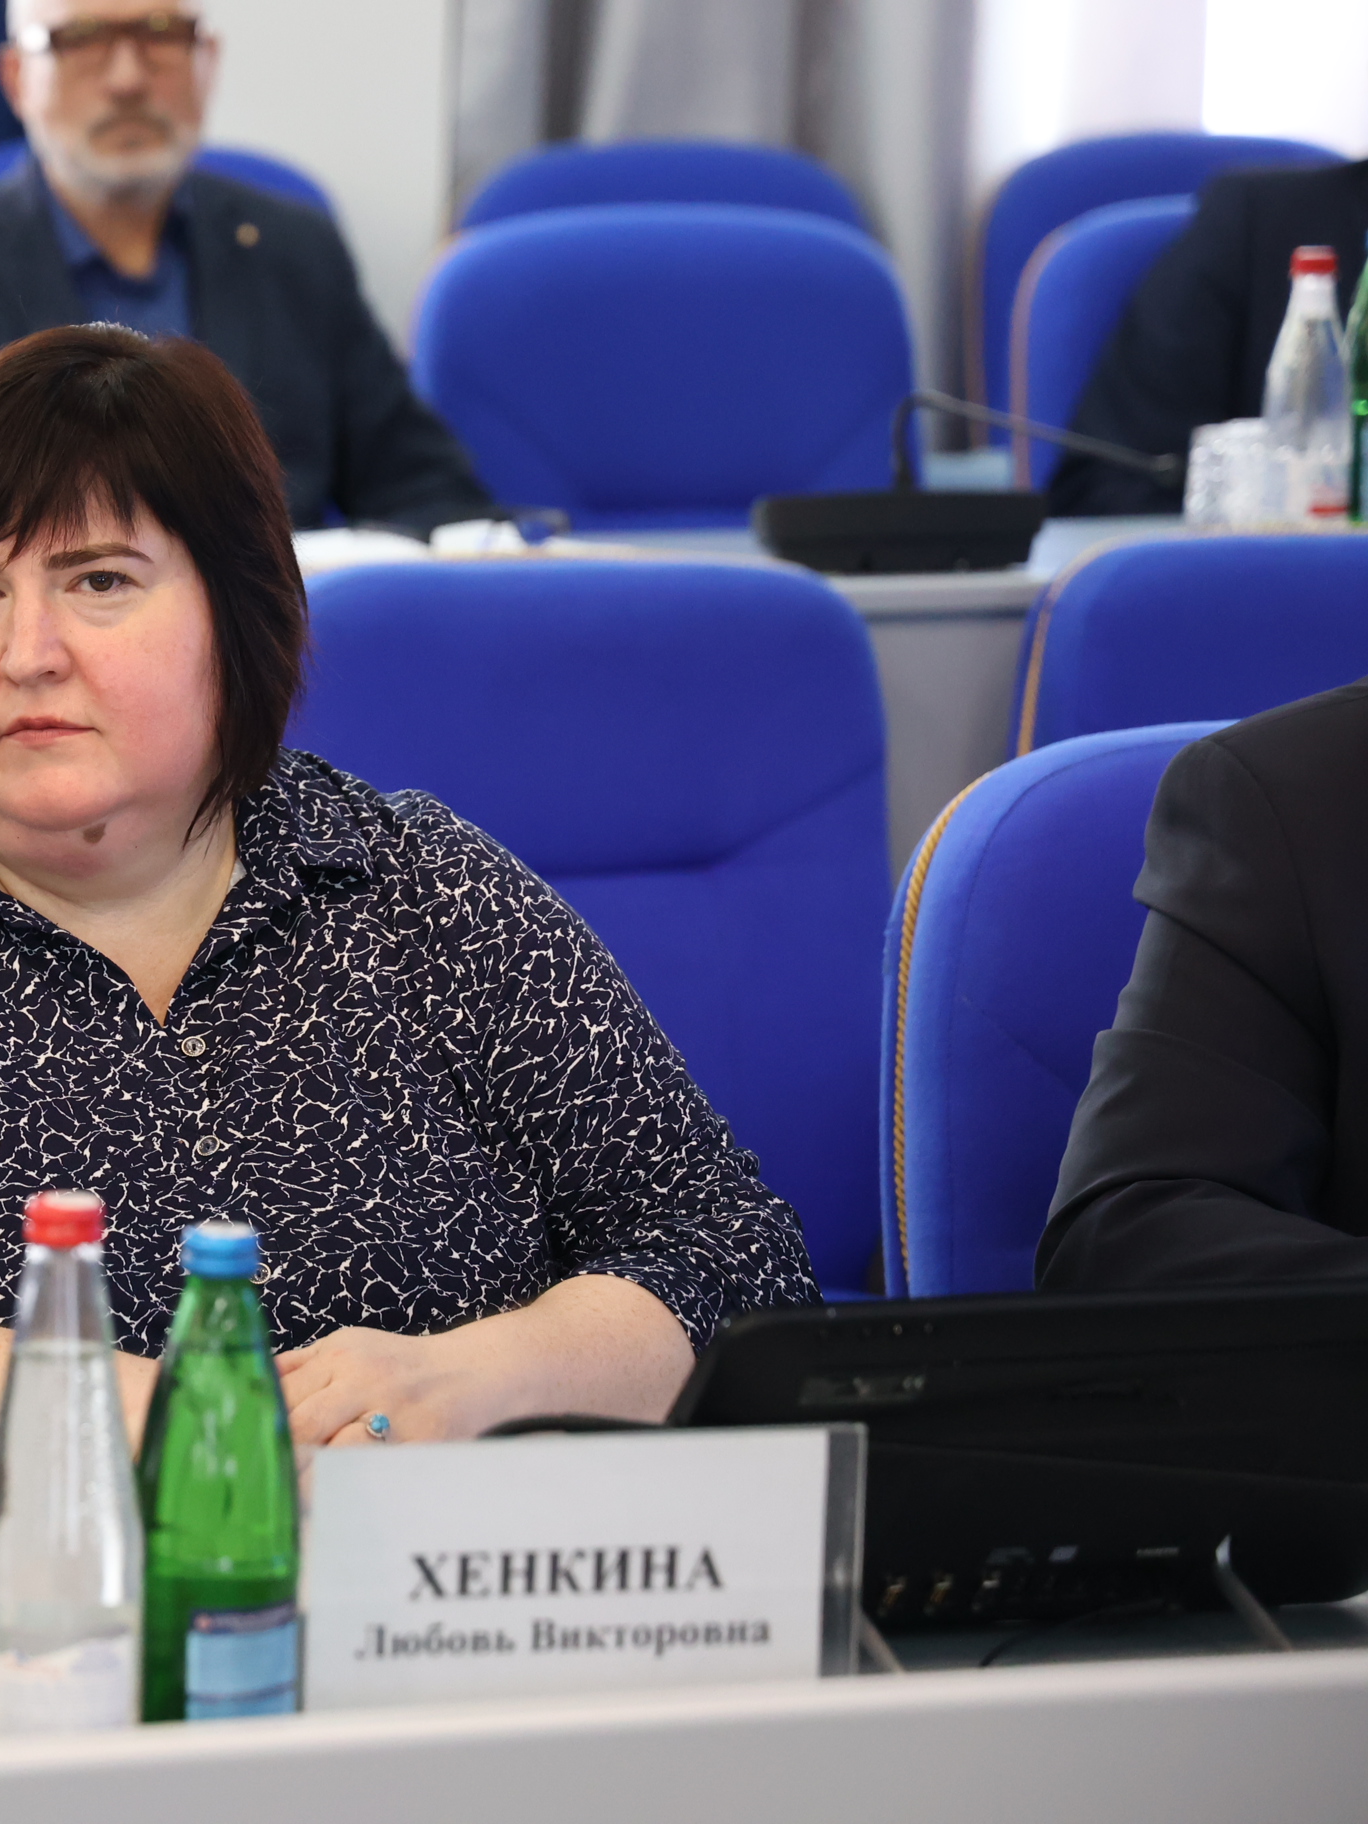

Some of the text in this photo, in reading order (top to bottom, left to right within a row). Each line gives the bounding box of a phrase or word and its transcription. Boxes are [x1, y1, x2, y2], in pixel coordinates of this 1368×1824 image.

[409, 1544, 724, 1602] ХЕНКИНА
[355, 1617, 771, 1660] Любовь Викторовна
